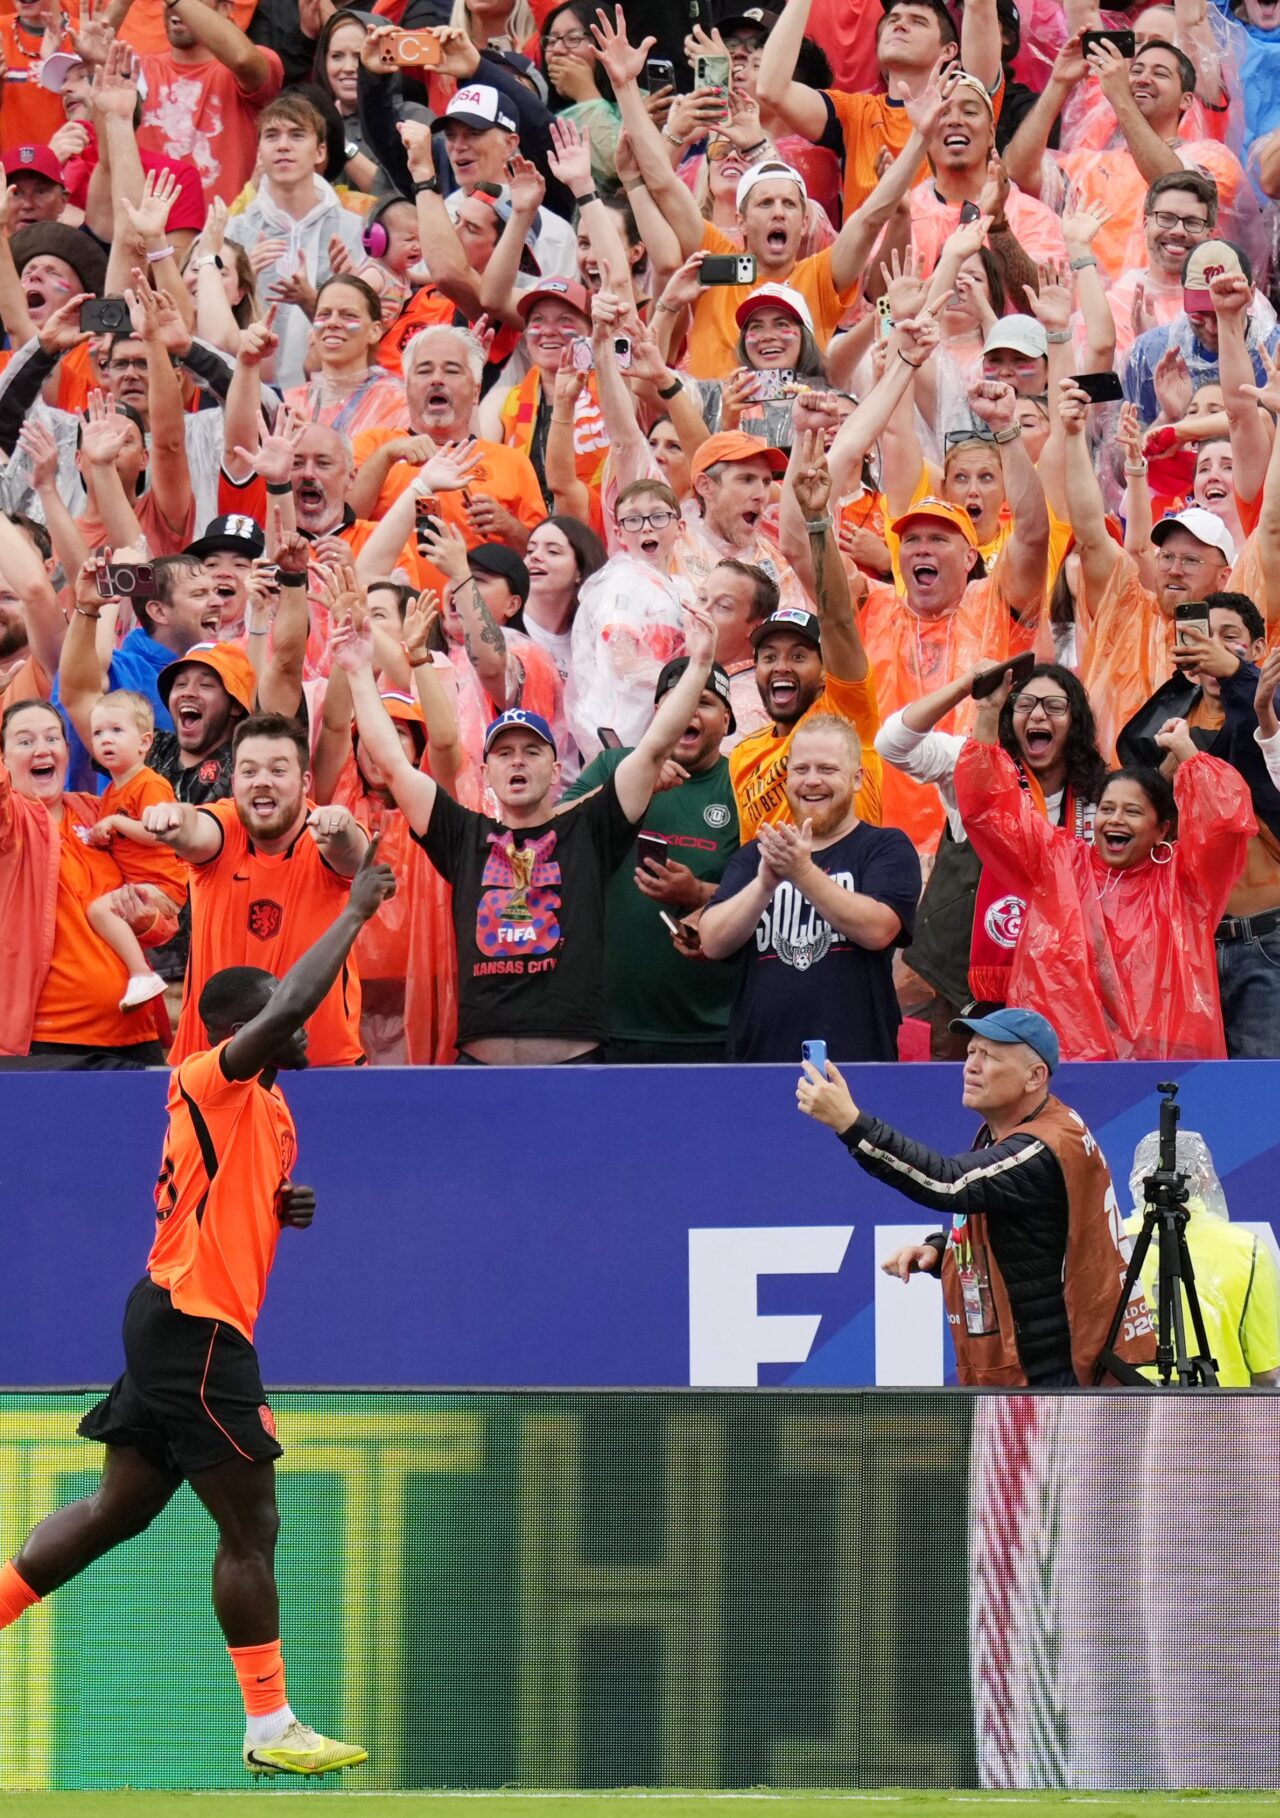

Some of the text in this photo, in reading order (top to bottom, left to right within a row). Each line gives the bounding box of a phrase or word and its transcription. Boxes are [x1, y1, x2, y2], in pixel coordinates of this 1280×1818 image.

[451, 89, 481, 106] USA
[503, 708, 526, 722] KC
[497, 926, 538, 943] FIFA
[473, 957, 558, 977] KANSAS CITY
